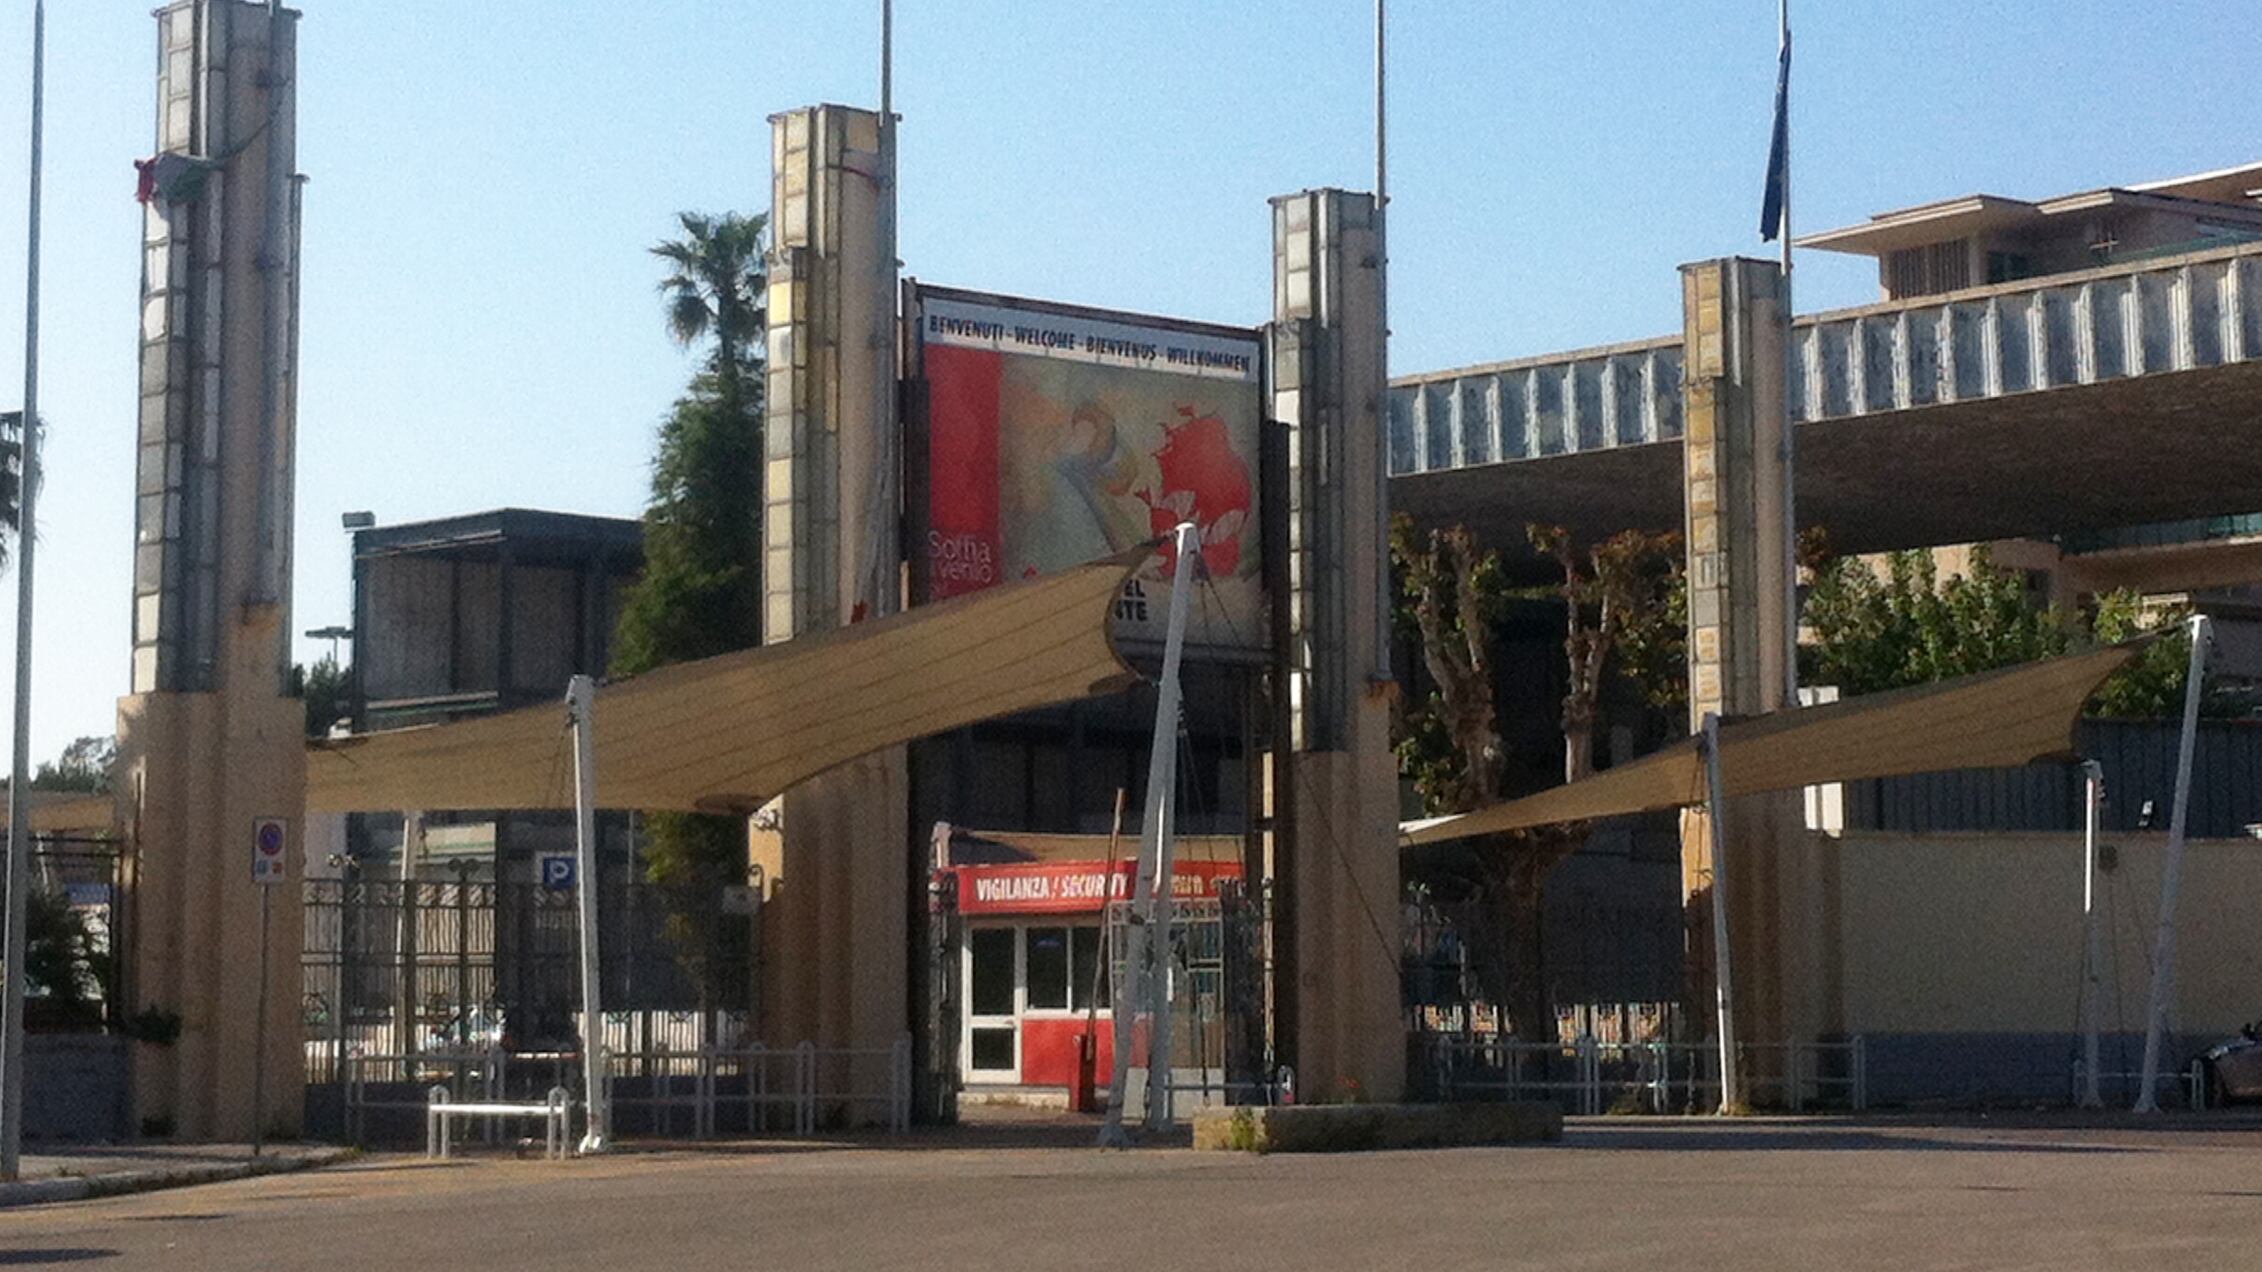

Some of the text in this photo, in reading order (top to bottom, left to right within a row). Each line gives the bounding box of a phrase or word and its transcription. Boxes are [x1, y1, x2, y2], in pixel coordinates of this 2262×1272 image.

[929, 315, 1004, 341] BENVENUTI
[1014, 326, 1075, 350] WELCOME
[1086, 334, 1157, 361] BIENVENUS
[1167, 346, 1250, 372] WILLKOMMEN
[1124, 579, 1146, 597] EL
[549, 860, 569, 884] P
[976, 876, 1050, 901] VIGILANZA
[1061, 872, 1128, 898] SECURTY
